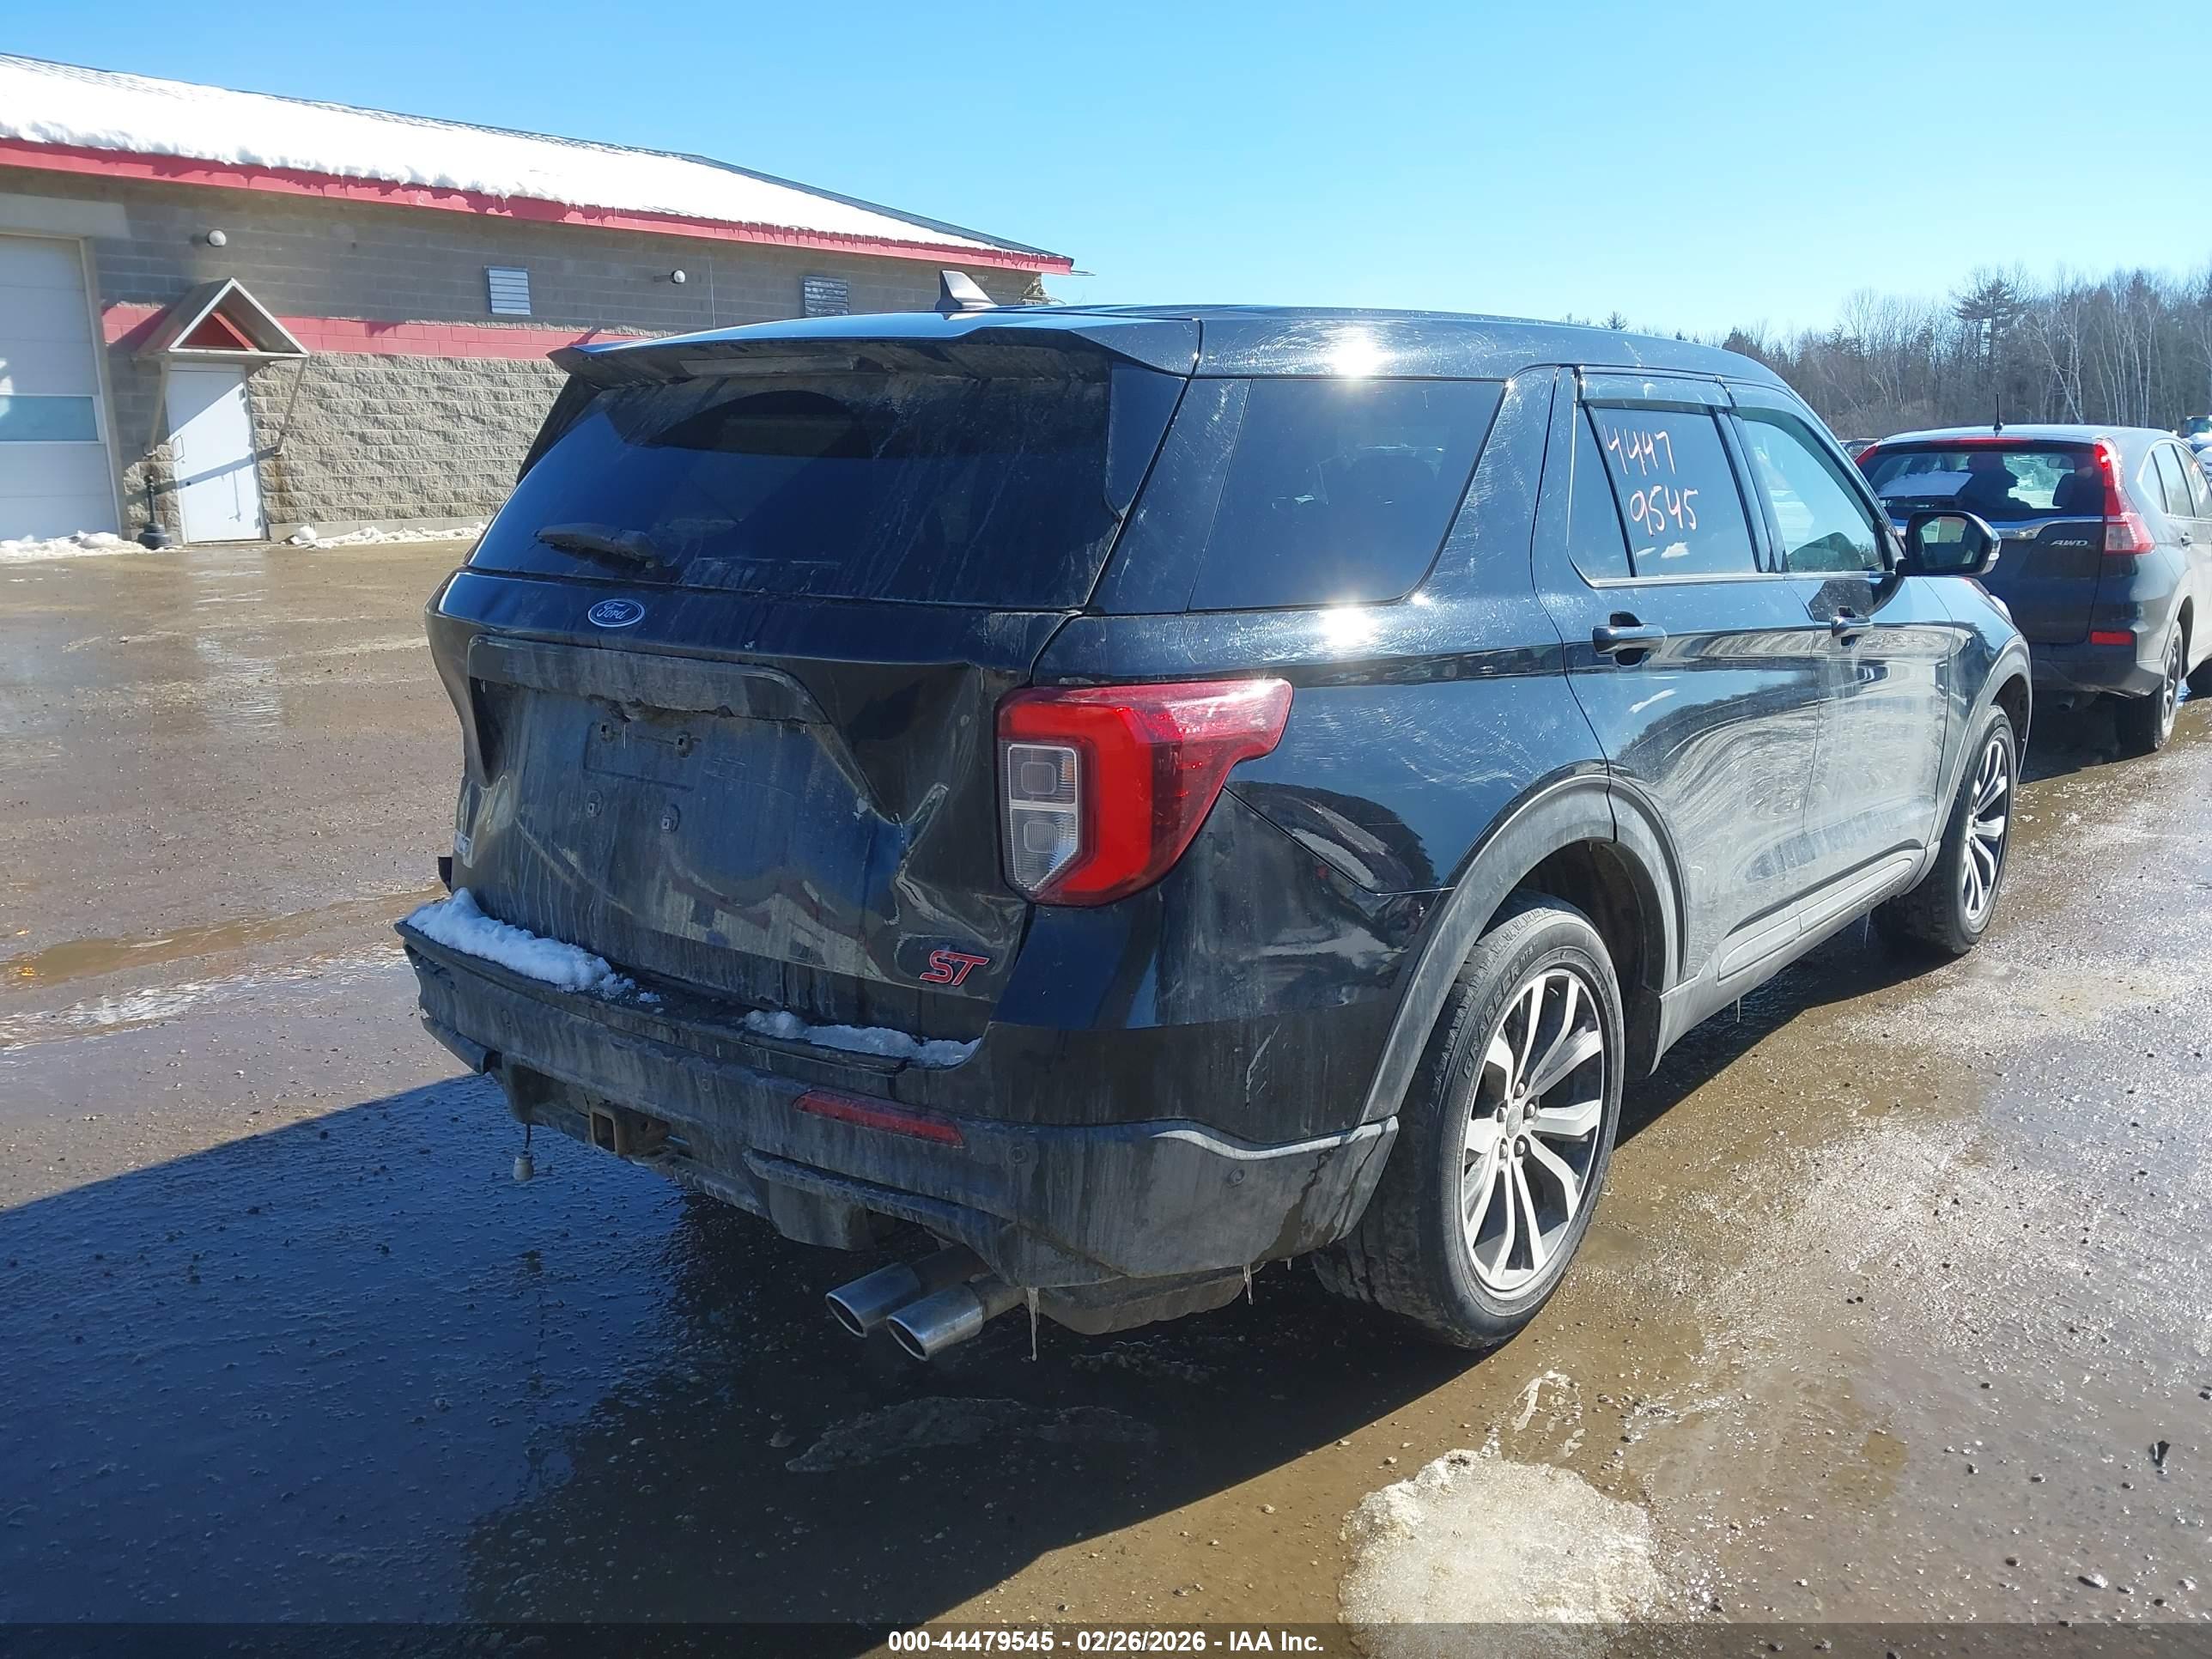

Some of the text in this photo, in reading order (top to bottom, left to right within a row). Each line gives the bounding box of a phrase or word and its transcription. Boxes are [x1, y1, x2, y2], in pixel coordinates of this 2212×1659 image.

[1602, 423, 1676, 477] 4447
[1629, 484, 1699, 538] 9545
[919, 949, 990, 986] ST
